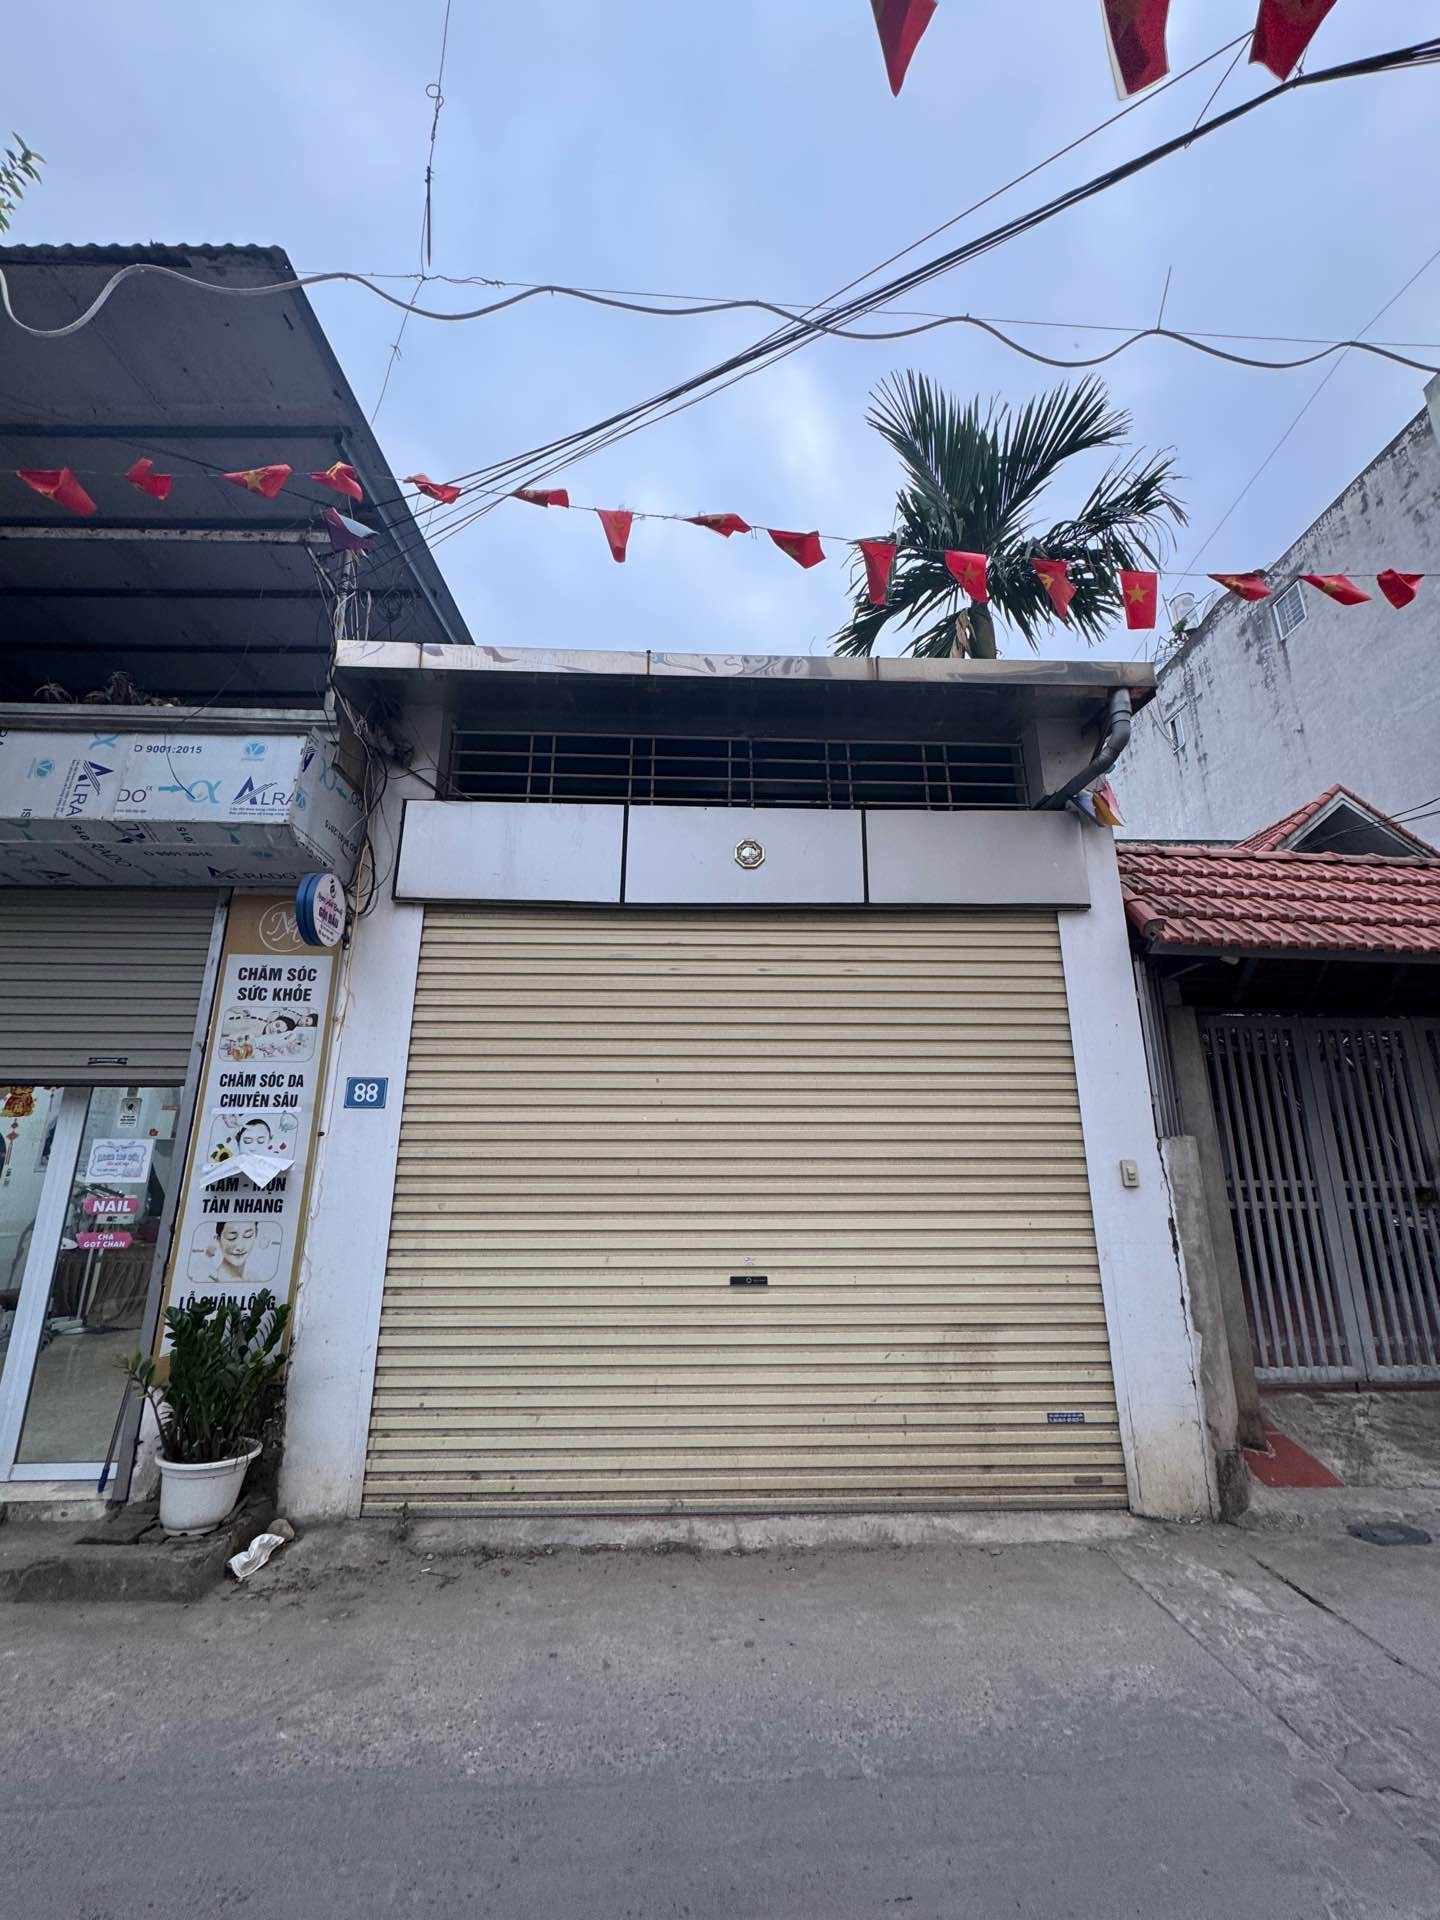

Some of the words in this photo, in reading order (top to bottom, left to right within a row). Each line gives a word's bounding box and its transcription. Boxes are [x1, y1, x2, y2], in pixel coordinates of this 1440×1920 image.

[146, 745, 202, 754] 9001:2015
[238, 965, 282, 981] CHĂM
[287, 965, 317, 982] SÓC
[237, 984, 268, 1001] SỨC
[272, 983, 312, 1002] KHỎE
[219, 1071, 256, 1087] CHĂM
[259, 1071, 285, 1087] SÓC
[288, 1074, 304, 1087] DA
[220, 1091, 270, 1107] CHUYÊN
[273, 1091, 298, 1107] SÂU
[353, 1082, 379, 1103] 88
[92, 1200, 131, 1213] NAIL
[233, 1198, 284, 1213] NHANG
[240, 1292, 276, 1311] LÔG
